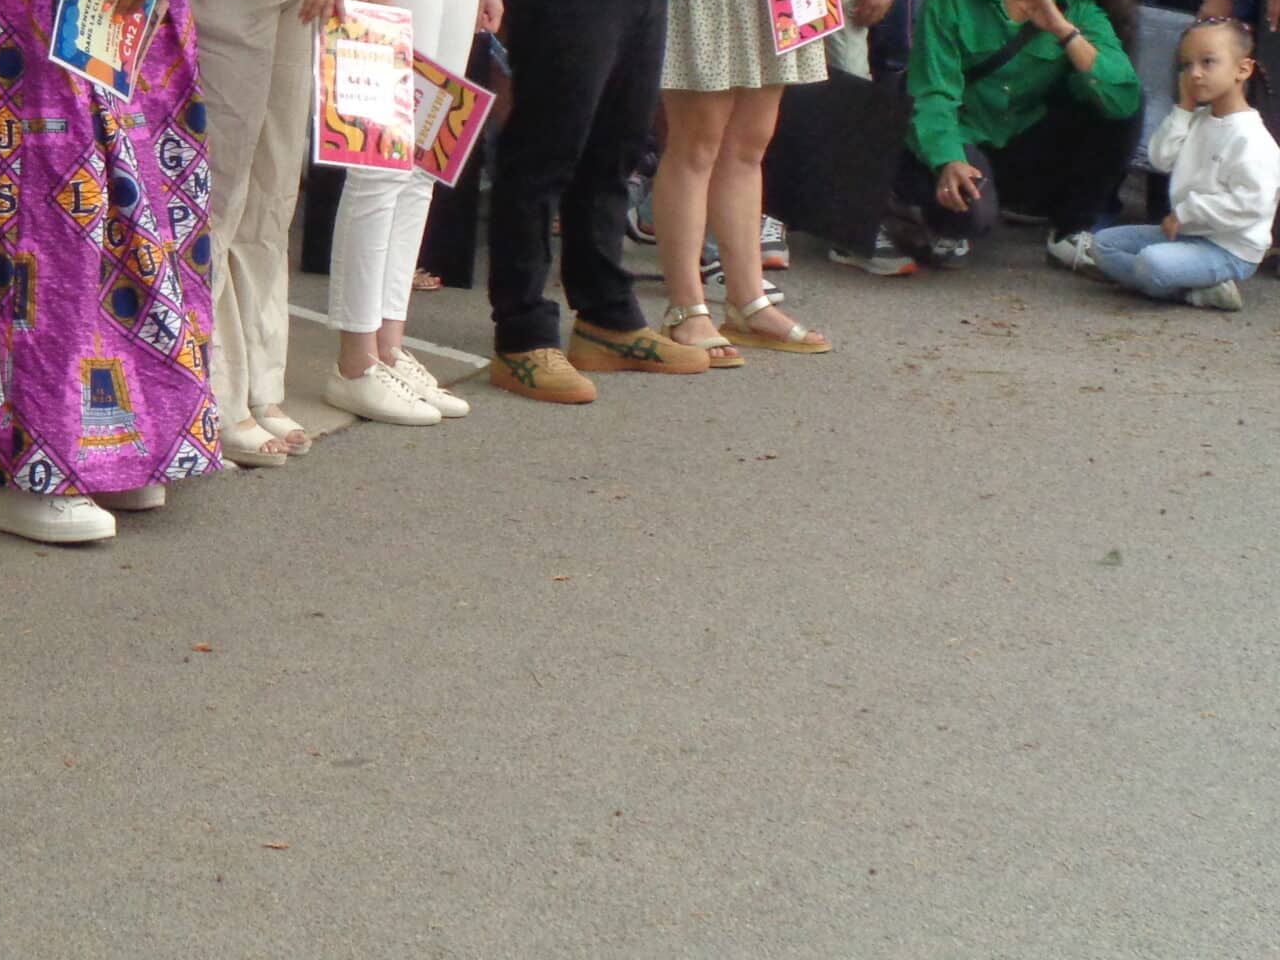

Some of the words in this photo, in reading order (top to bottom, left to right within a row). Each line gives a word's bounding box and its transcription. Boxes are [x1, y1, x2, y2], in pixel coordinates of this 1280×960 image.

[96, 13, 104, 26] DE
[123, 25, 138, 56] CM2
[133, 12, 142, 23] A
[84, 27, 94, 53] DANS
[160, 137, 183, 170] G
[71, 182, 98, 214] L
